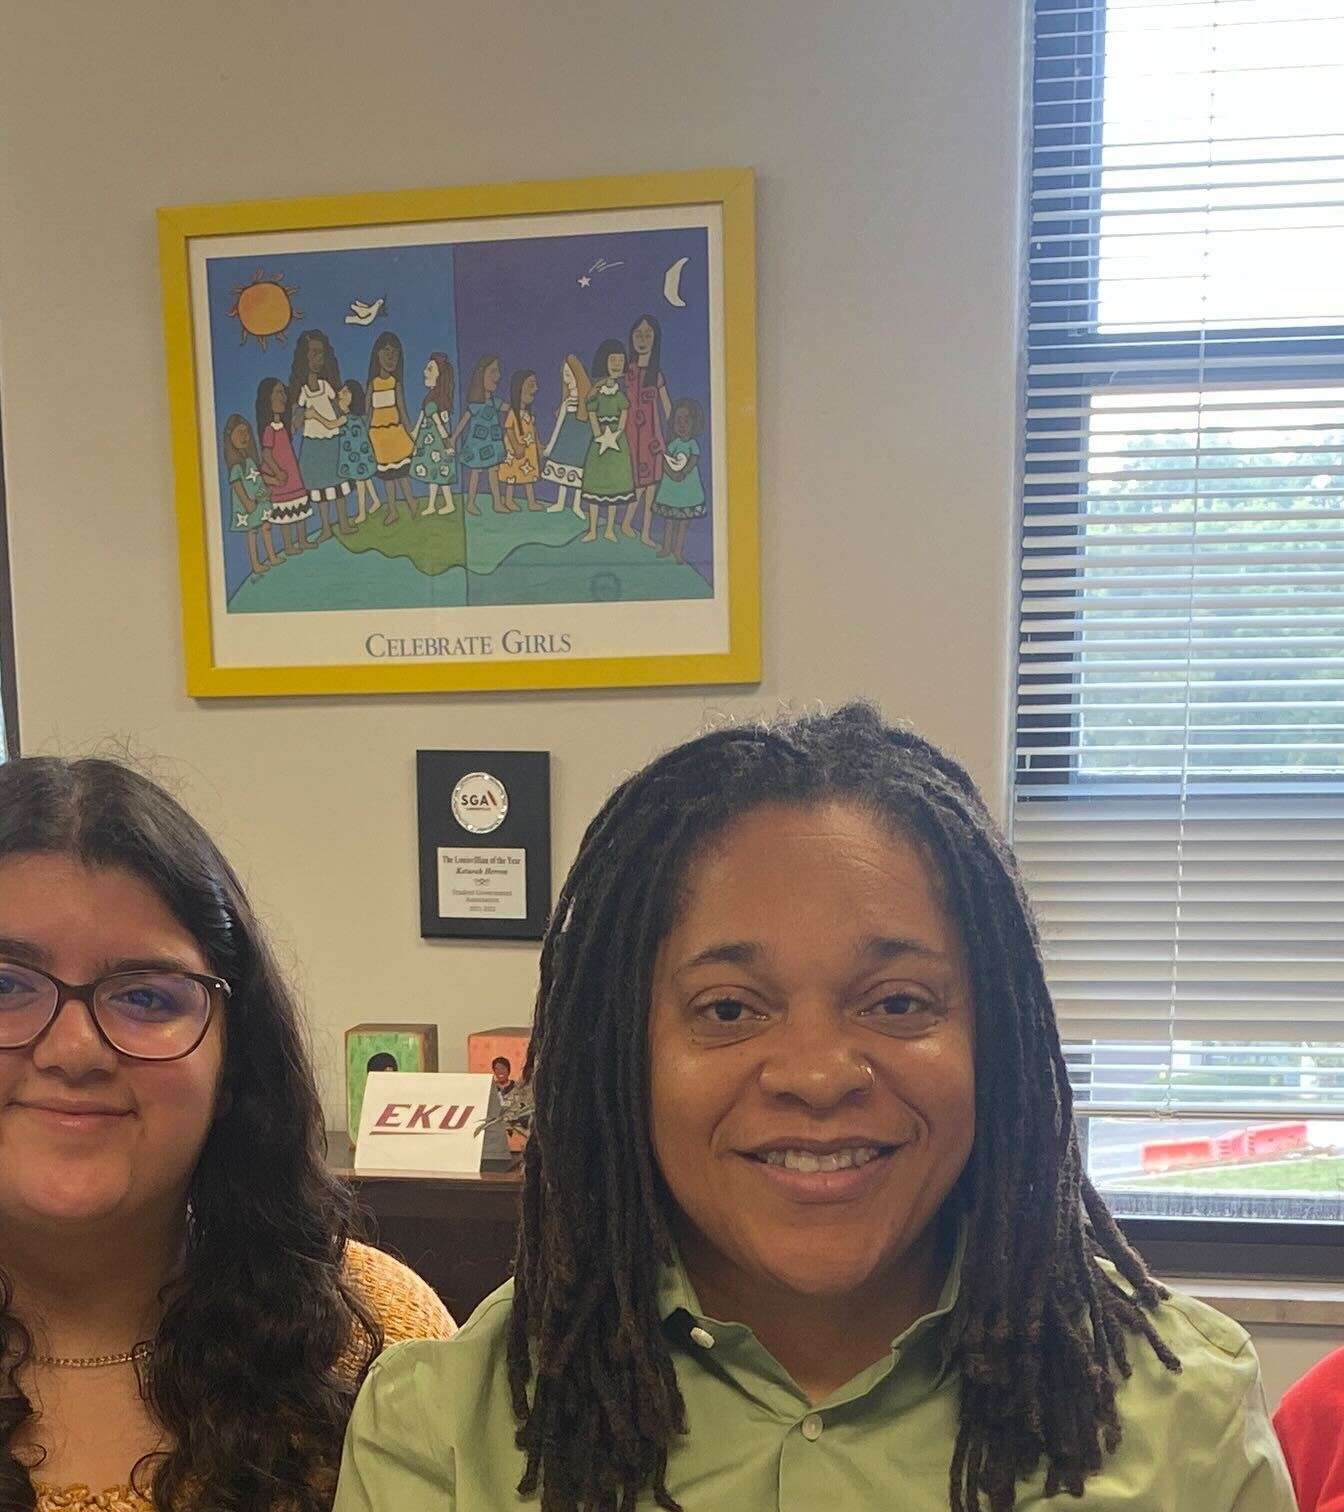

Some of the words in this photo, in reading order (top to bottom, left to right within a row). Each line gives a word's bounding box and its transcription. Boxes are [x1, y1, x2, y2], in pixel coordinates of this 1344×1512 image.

[365, 633, 492, 658] CELEBRATE
[502, 629, 572, 655] GIRLS
[461, 794, 489, 806] SGA
[374, 1103, 475, 1130] EKU
